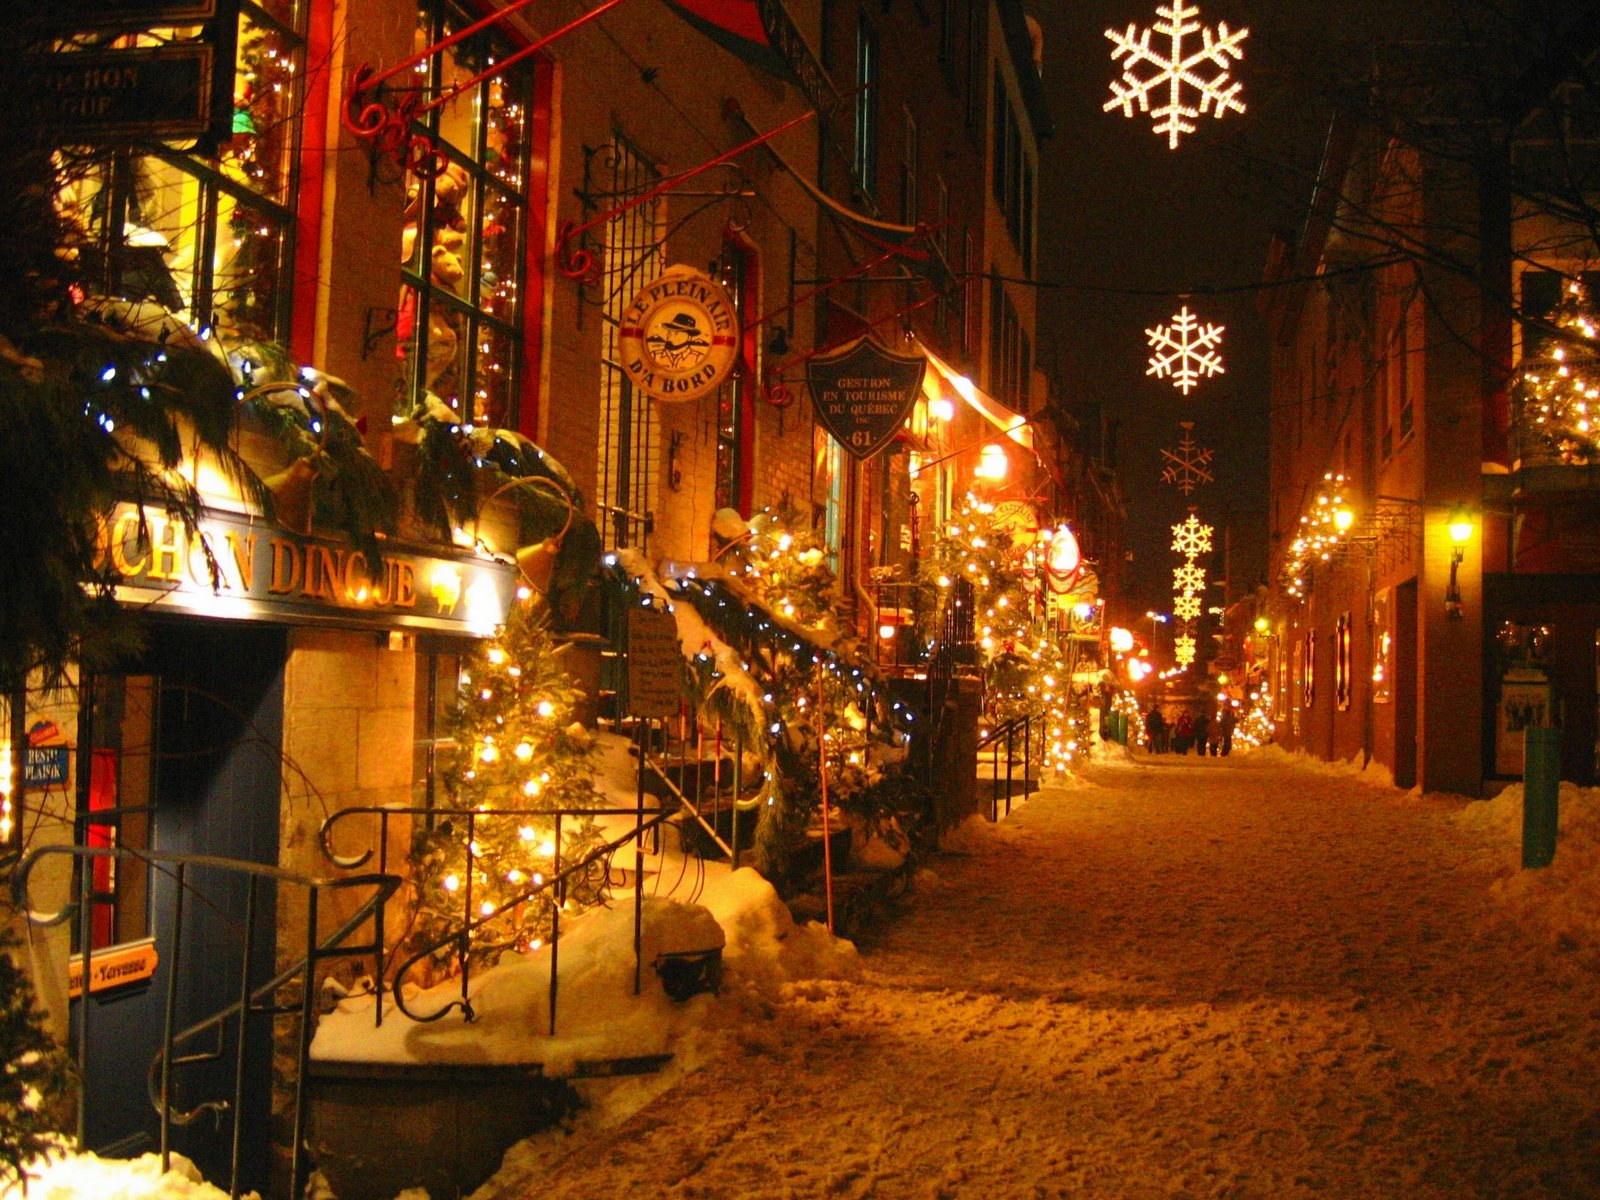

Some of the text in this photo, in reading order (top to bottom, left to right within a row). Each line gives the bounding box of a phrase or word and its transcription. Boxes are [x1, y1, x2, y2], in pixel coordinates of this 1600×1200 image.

[627, 280, 731, 331] LE PLEIN AIR
[662, 364, 716, 393] BORD
[837, 378, 891, 388] GESTION
[823, 391, 906, 401] EN TOURISME
[829, 402, 898, 416] DU QUÉBEC
[852, 431, 872, 446] 61
